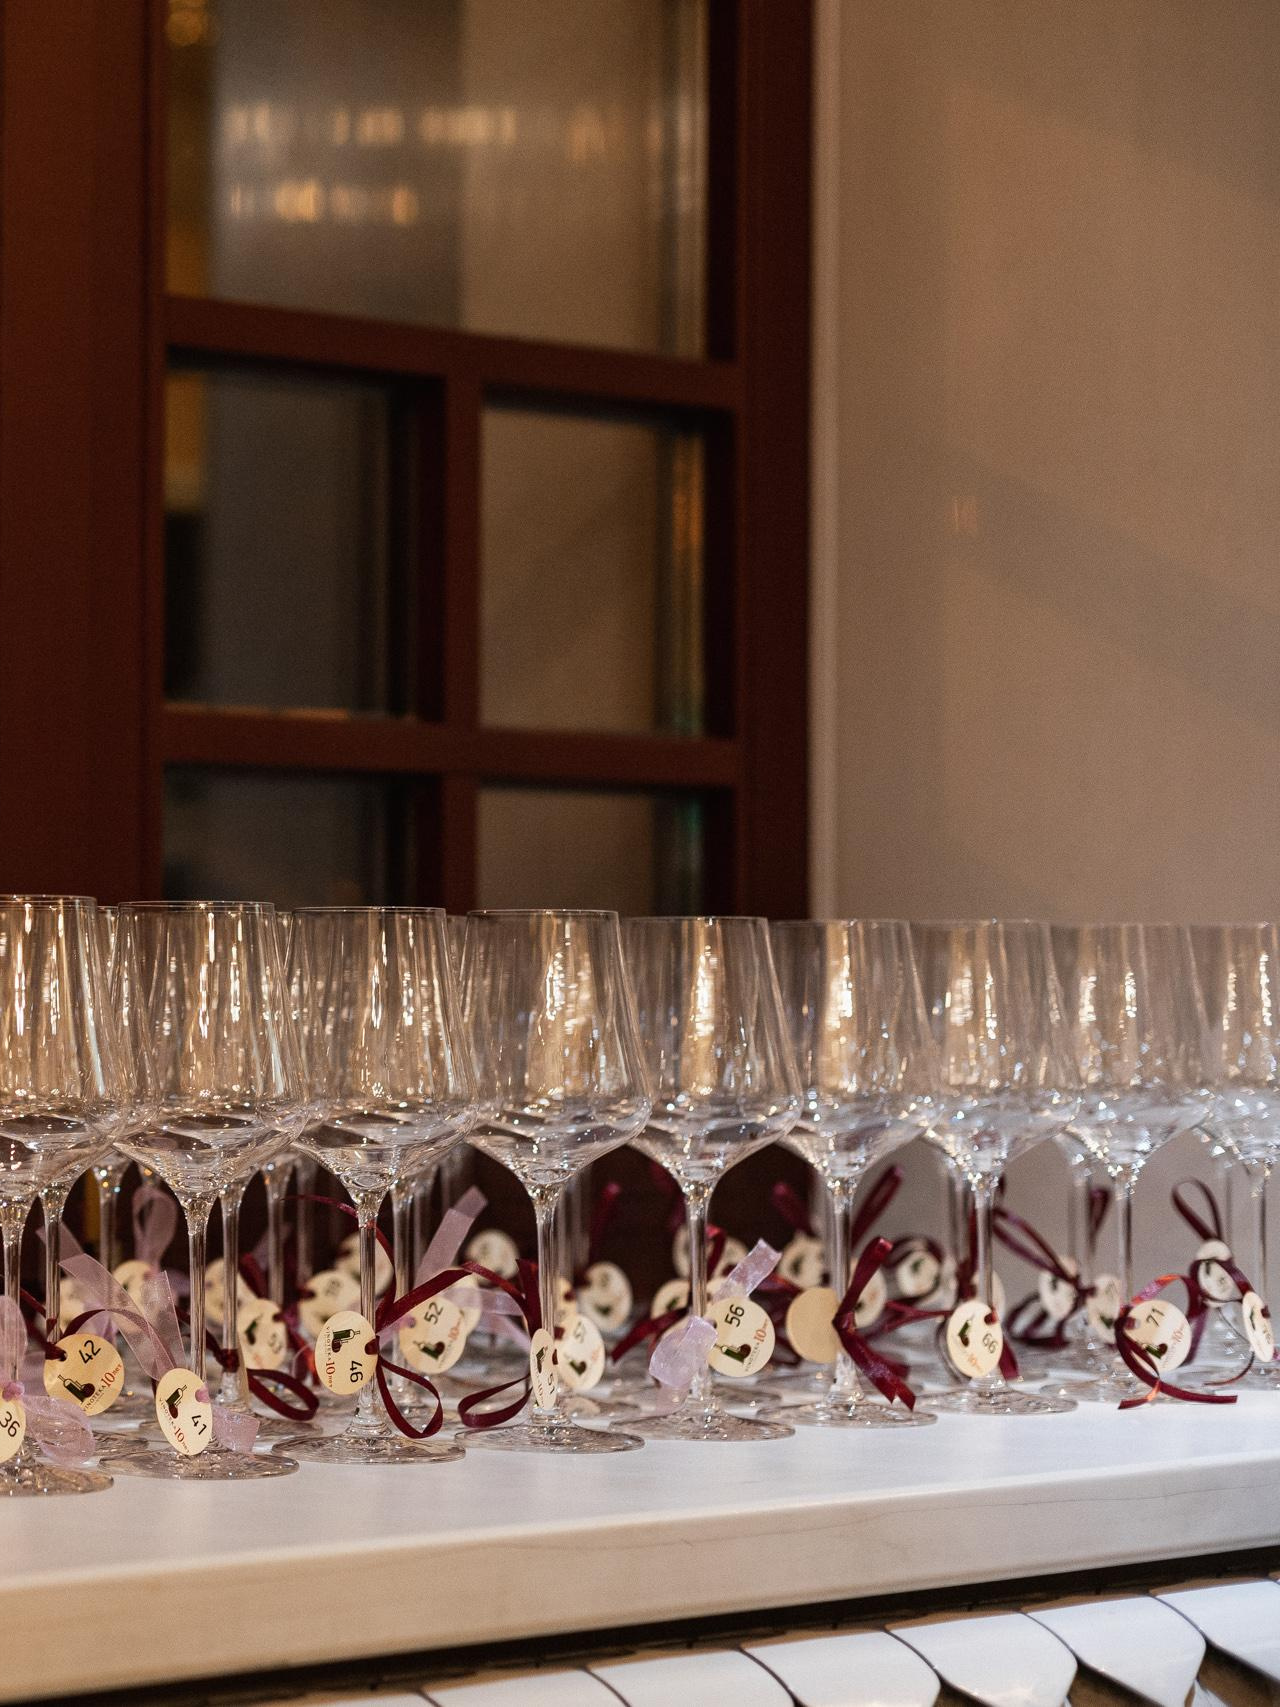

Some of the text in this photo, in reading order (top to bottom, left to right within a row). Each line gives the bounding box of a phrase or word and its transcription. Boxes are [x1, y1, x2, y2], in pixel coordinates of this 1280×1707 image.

[424, 1302, 444, 1325] 52
[724, 1304, 745, 1328] 56
[1146, 1308, 1165, 1327] 71
[79, 1339, 101, 1364] 42
[982, 1333, 998, 1354] 66
[350, 1360, 364, 1383] 46
[0, 1410, 21, 1437] 36
[191, 1415, 207, 1435] 41
